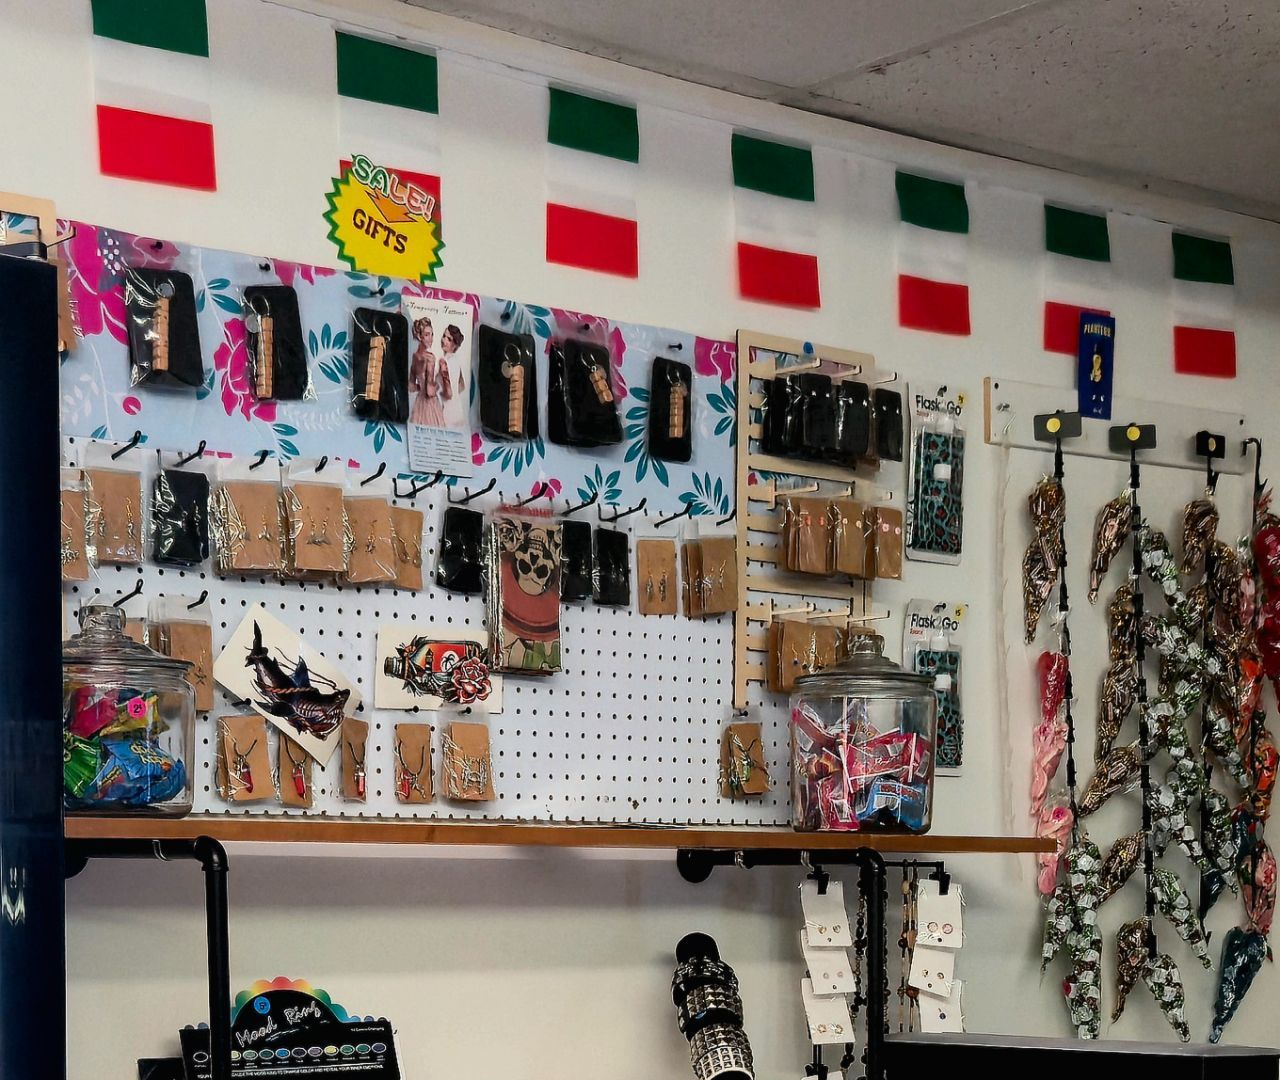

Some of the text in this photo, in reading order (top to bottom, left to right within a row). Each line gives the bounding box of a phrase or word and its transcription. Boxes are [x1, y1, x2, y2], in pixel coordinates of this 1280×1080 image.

[352, 155, 435, 222] SALE!
[353, 209, 408, 254] GIFTS
[236, 1016, 277, 1047] Mood
